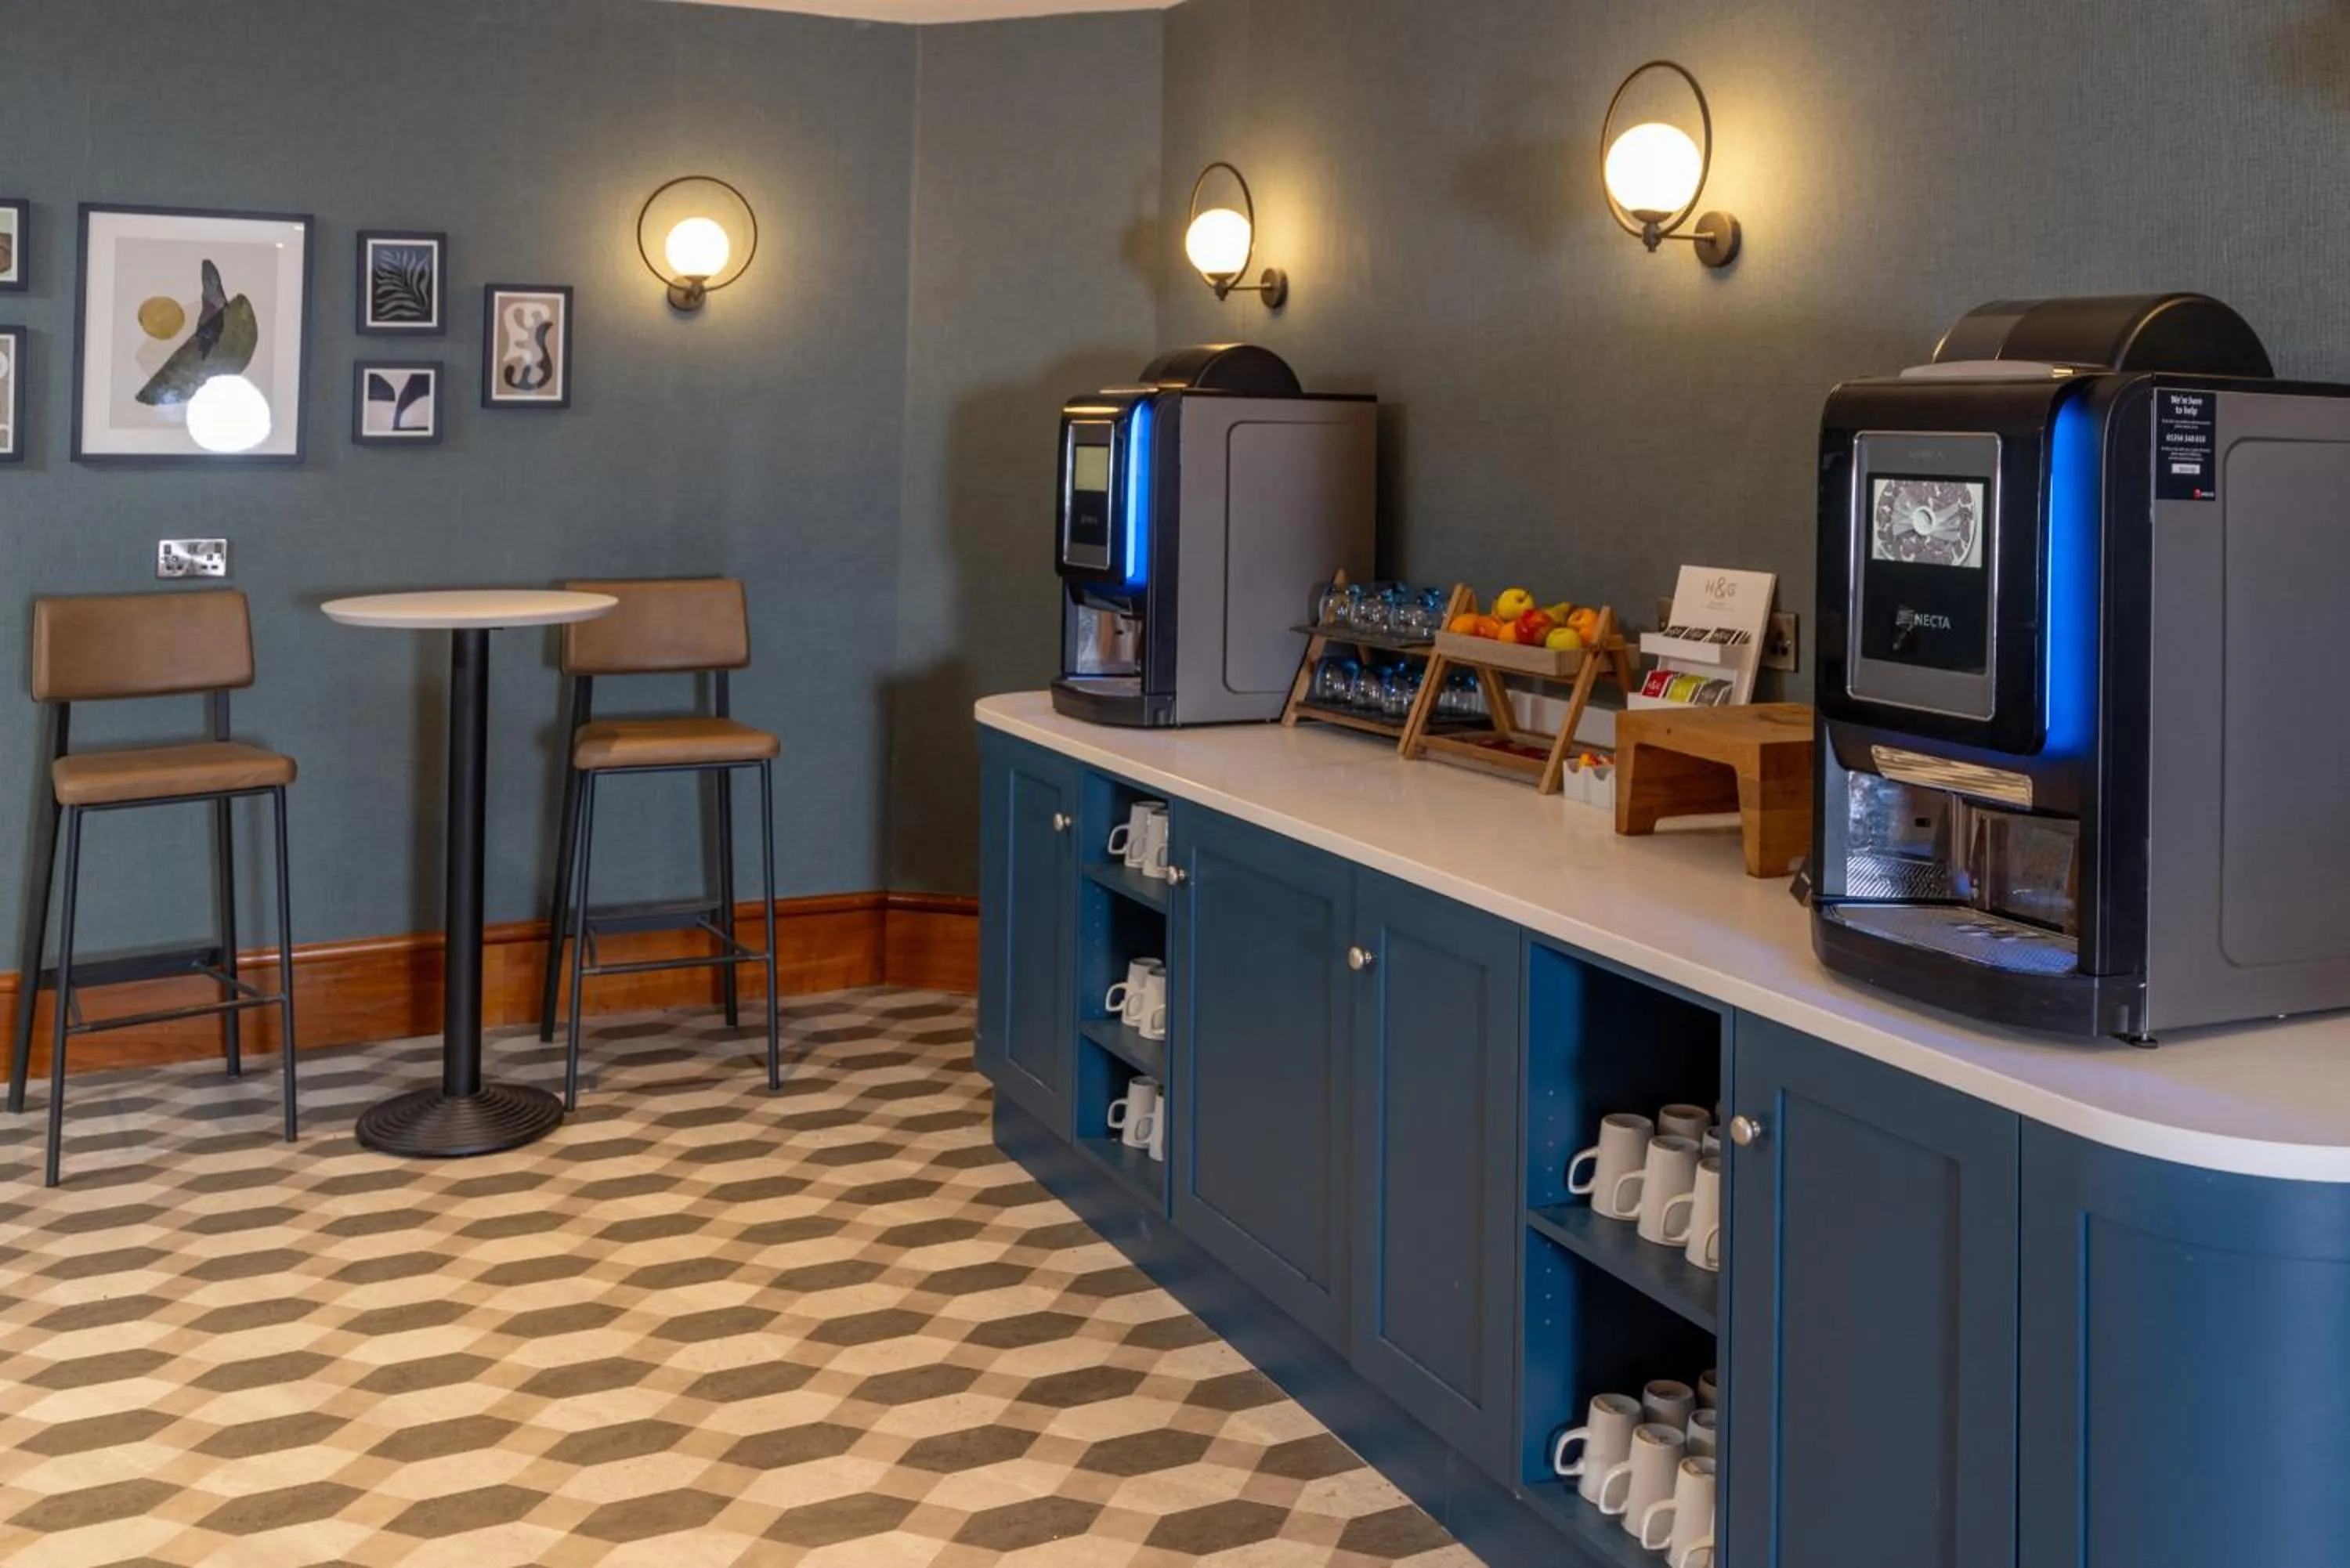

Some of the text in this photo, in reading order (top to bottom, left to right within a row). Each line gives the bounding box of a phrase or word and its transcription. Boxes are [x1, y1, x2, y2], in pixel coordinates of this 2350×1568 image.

[2175, 405, 2198, 417] to help
[1914, 613, 1951, 629] NECTA
